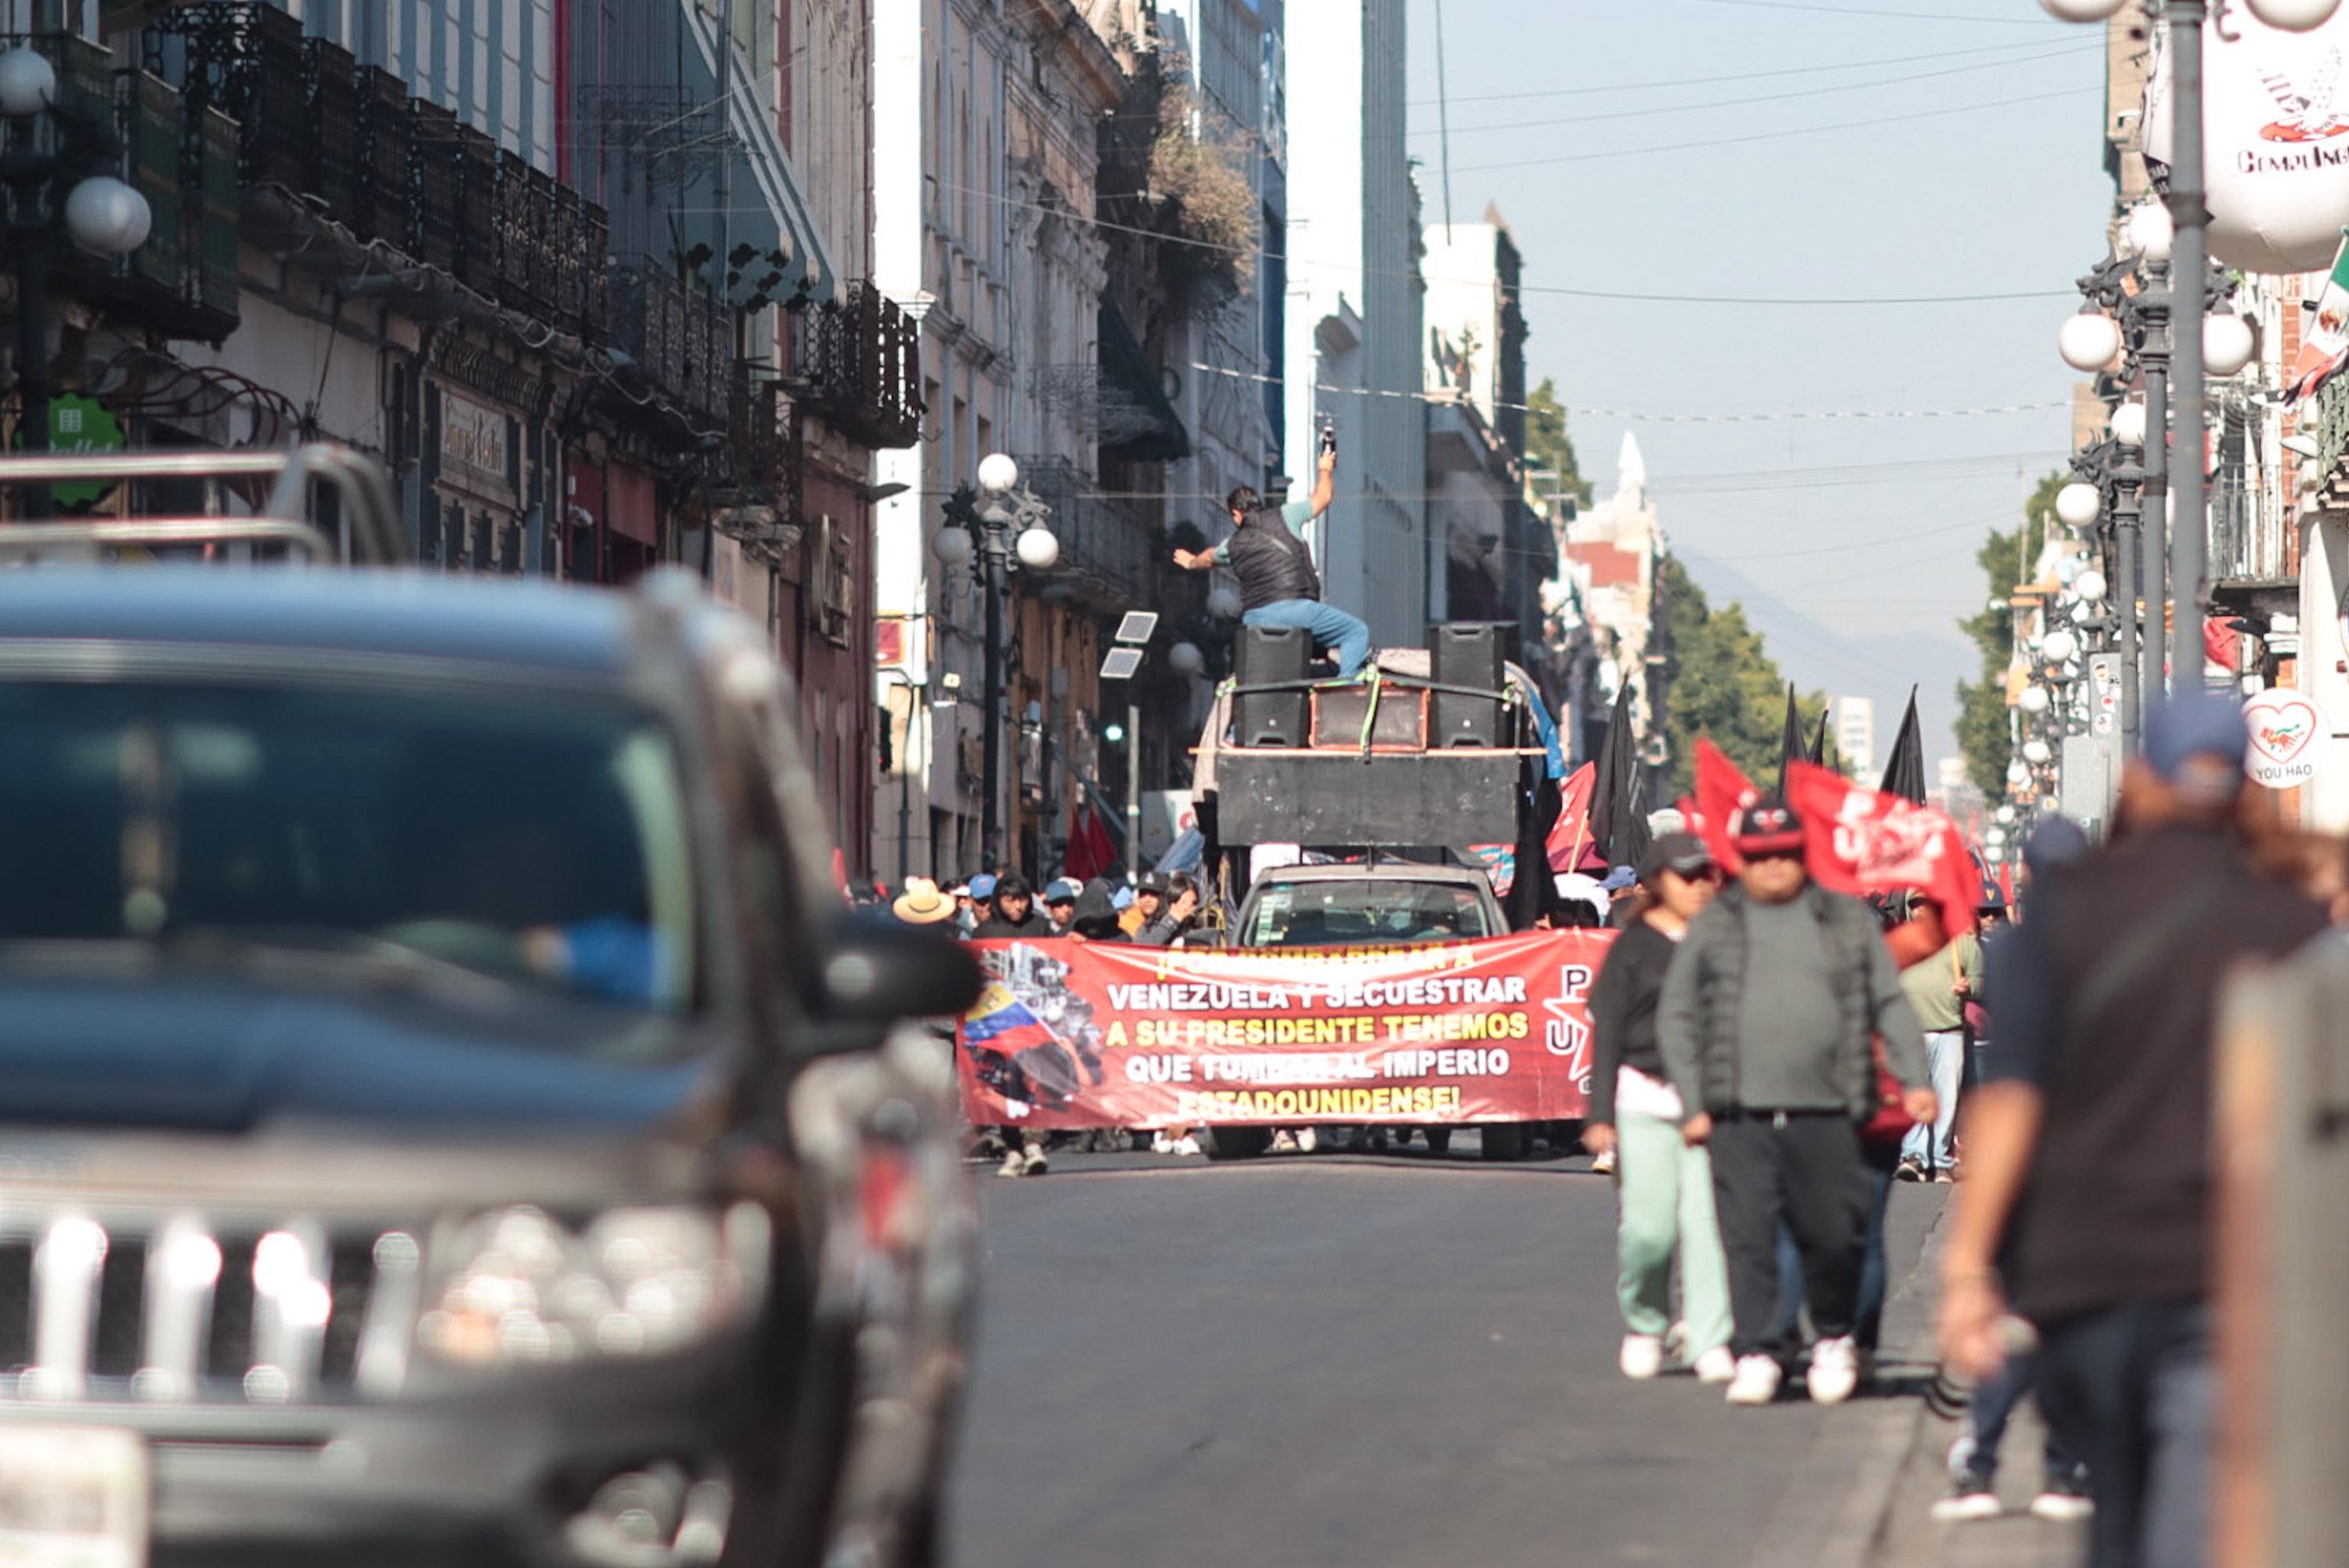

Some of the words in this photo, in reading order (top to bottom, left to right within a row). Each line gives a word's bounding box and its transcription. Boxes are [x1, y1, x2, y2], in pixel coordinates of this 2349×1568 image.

[2257, 767, 2282, 780] YOU
[2286, 764, 2312, 777] HAO
[1107, 982, 1290, 1011] VENEZUELA
[1295, 982, 1315, 1009] Y
[1325, 975, 1528, 1008] SECUESTRAR
[1105, 1021, 1129, 1047] A
[1135, 1019, 1178, 1046] SU
[1185, 1016, 1375, 1046] PRESIDENTE
[1383, 1011, 1529, 1043] TENEMOS
[1125, 1055, 1193, 1084] QUE
[1383, 1047, 1510, 1079] IMPERIO
[1178, 1086, 1460, 1118] ESTADOUNIDENSE!
